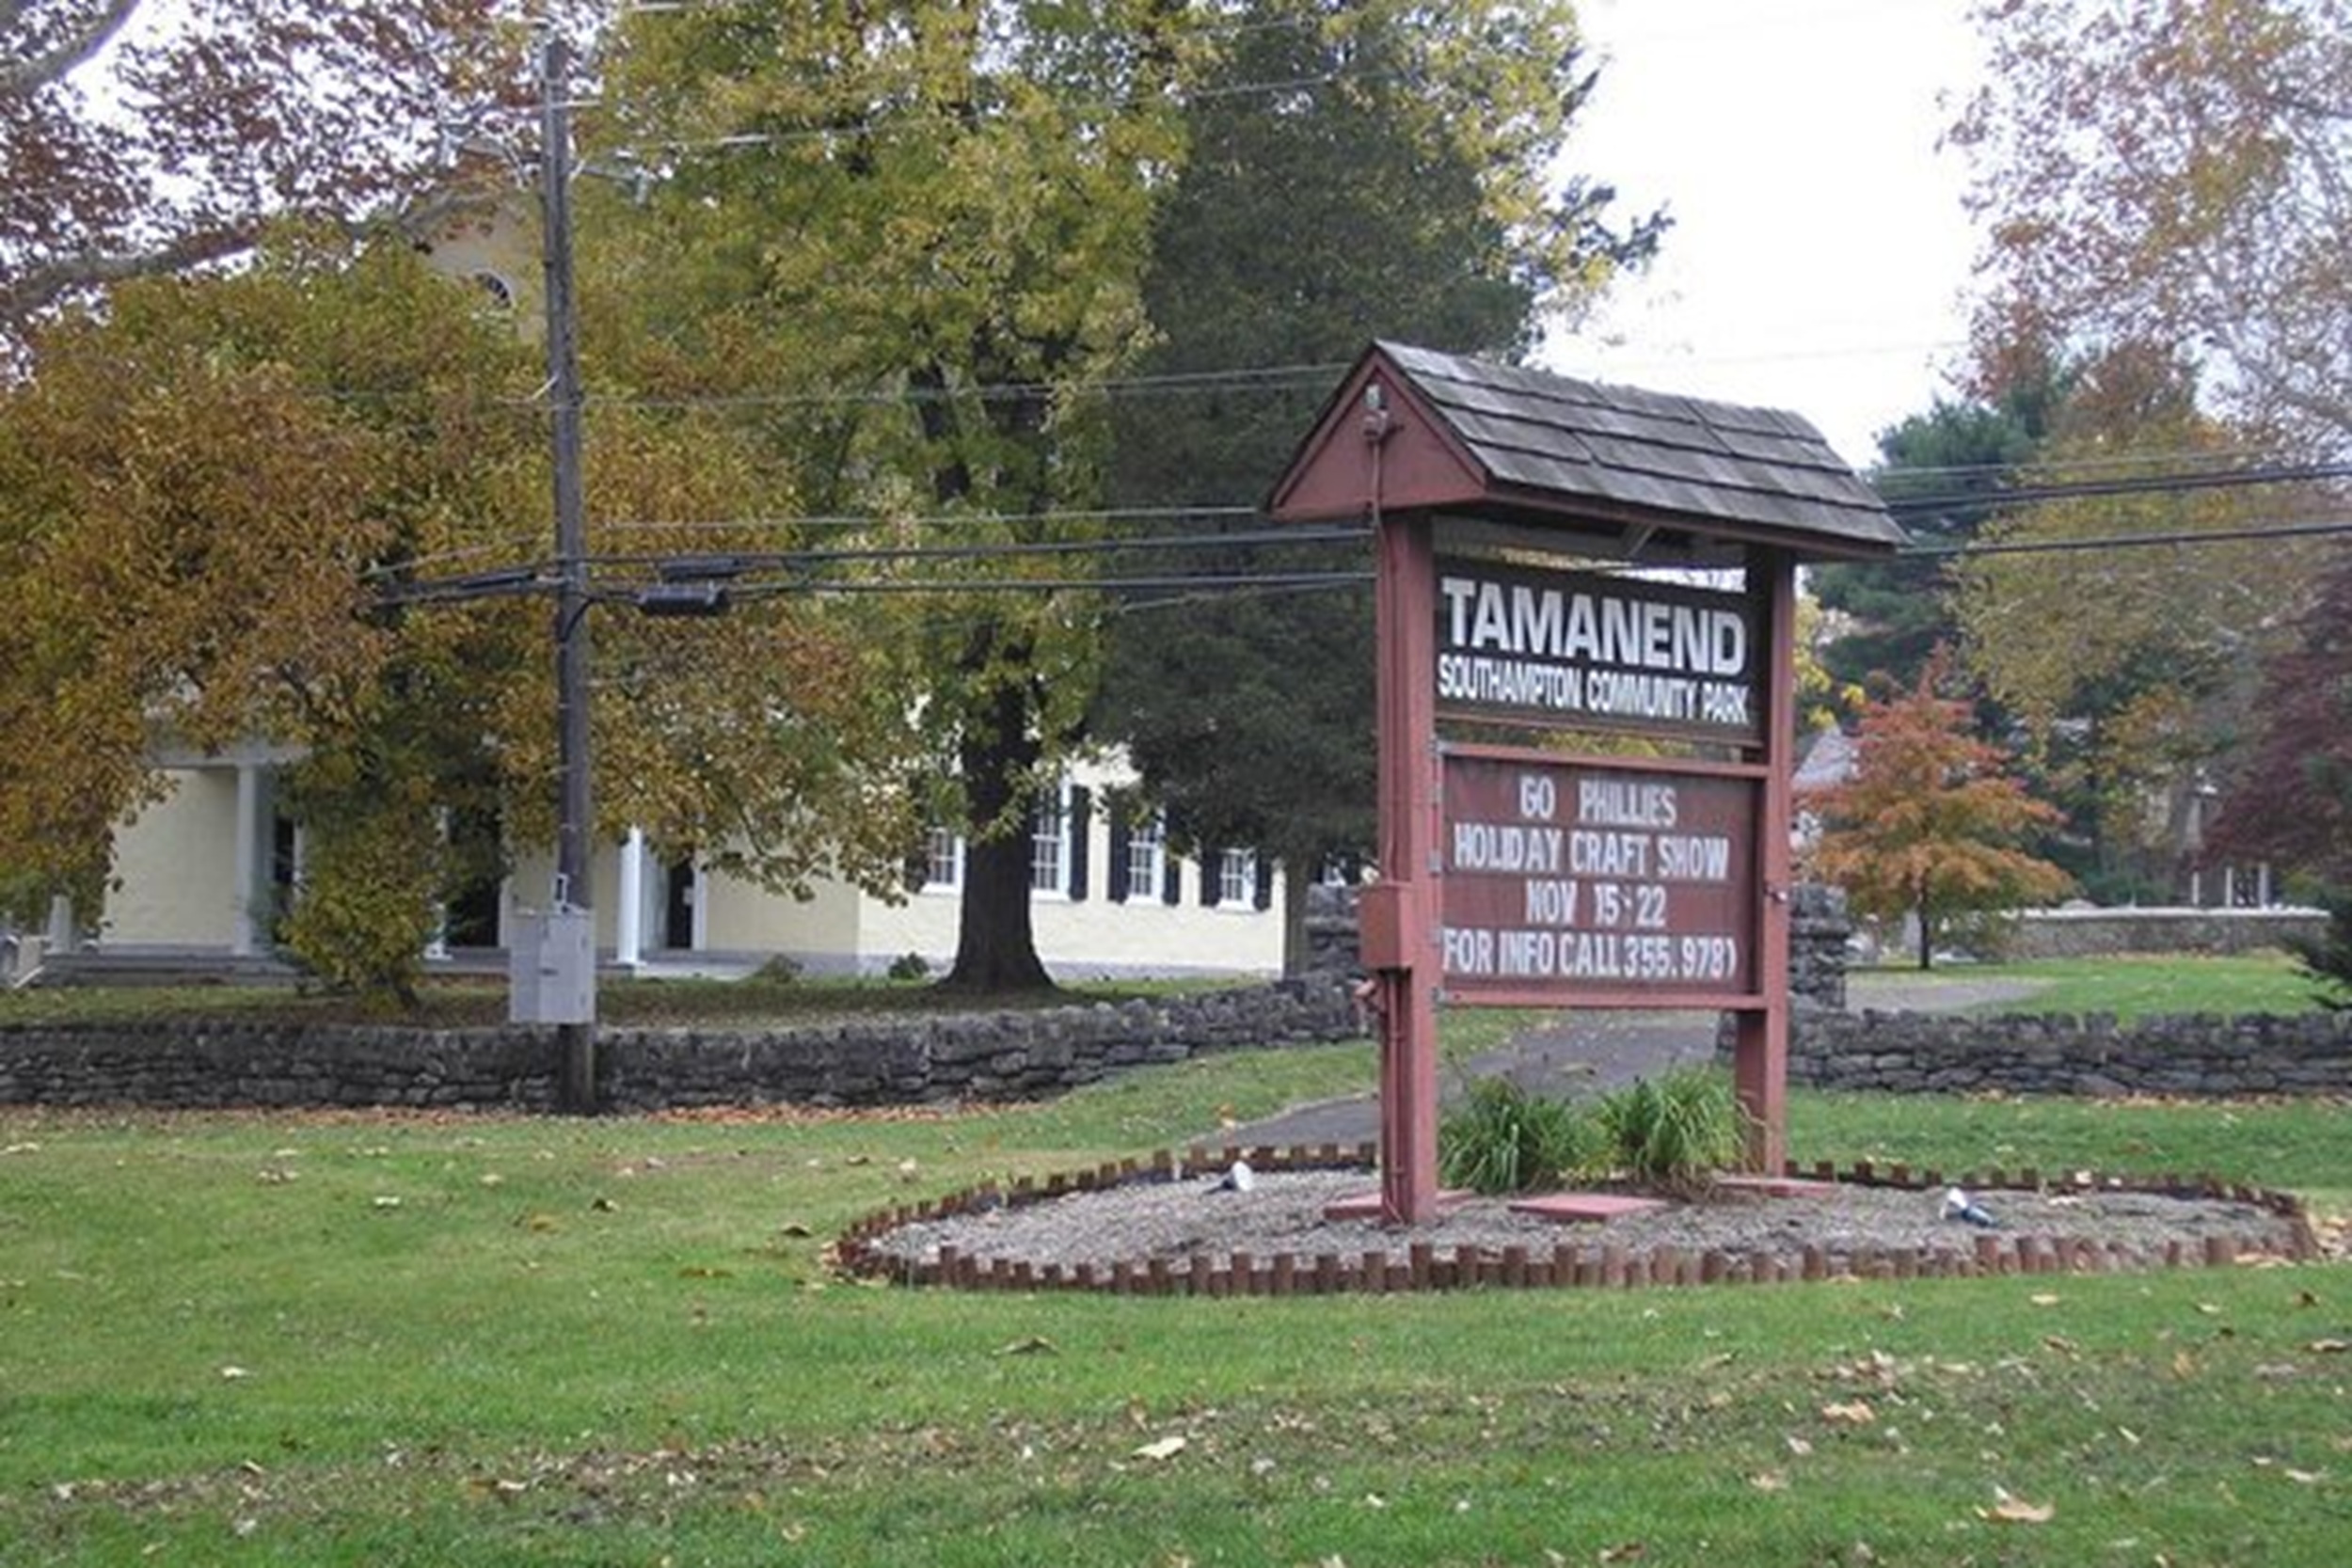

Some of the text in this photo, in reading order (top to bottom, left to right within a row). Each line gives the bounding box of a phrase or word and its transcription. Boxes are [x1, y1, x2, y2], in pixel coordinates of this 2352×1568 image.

[1441, 577, 1747, 676] TAMANEND
[1439, 653, 1749, 723] SOUTHAMPTON COMMUNITY PARK
[1519, 776, 1677, 827] GO PHILLIES
[1454, 823, 1729, 879] HOLIDAY CRAFT SHOW
[1526, 880, 1578, 925] NOV
[1442, 927, 1494, 974] FOR
[1499, 930, 1554, 976] INFO
[1559, 933, 1621, 977] CALL
